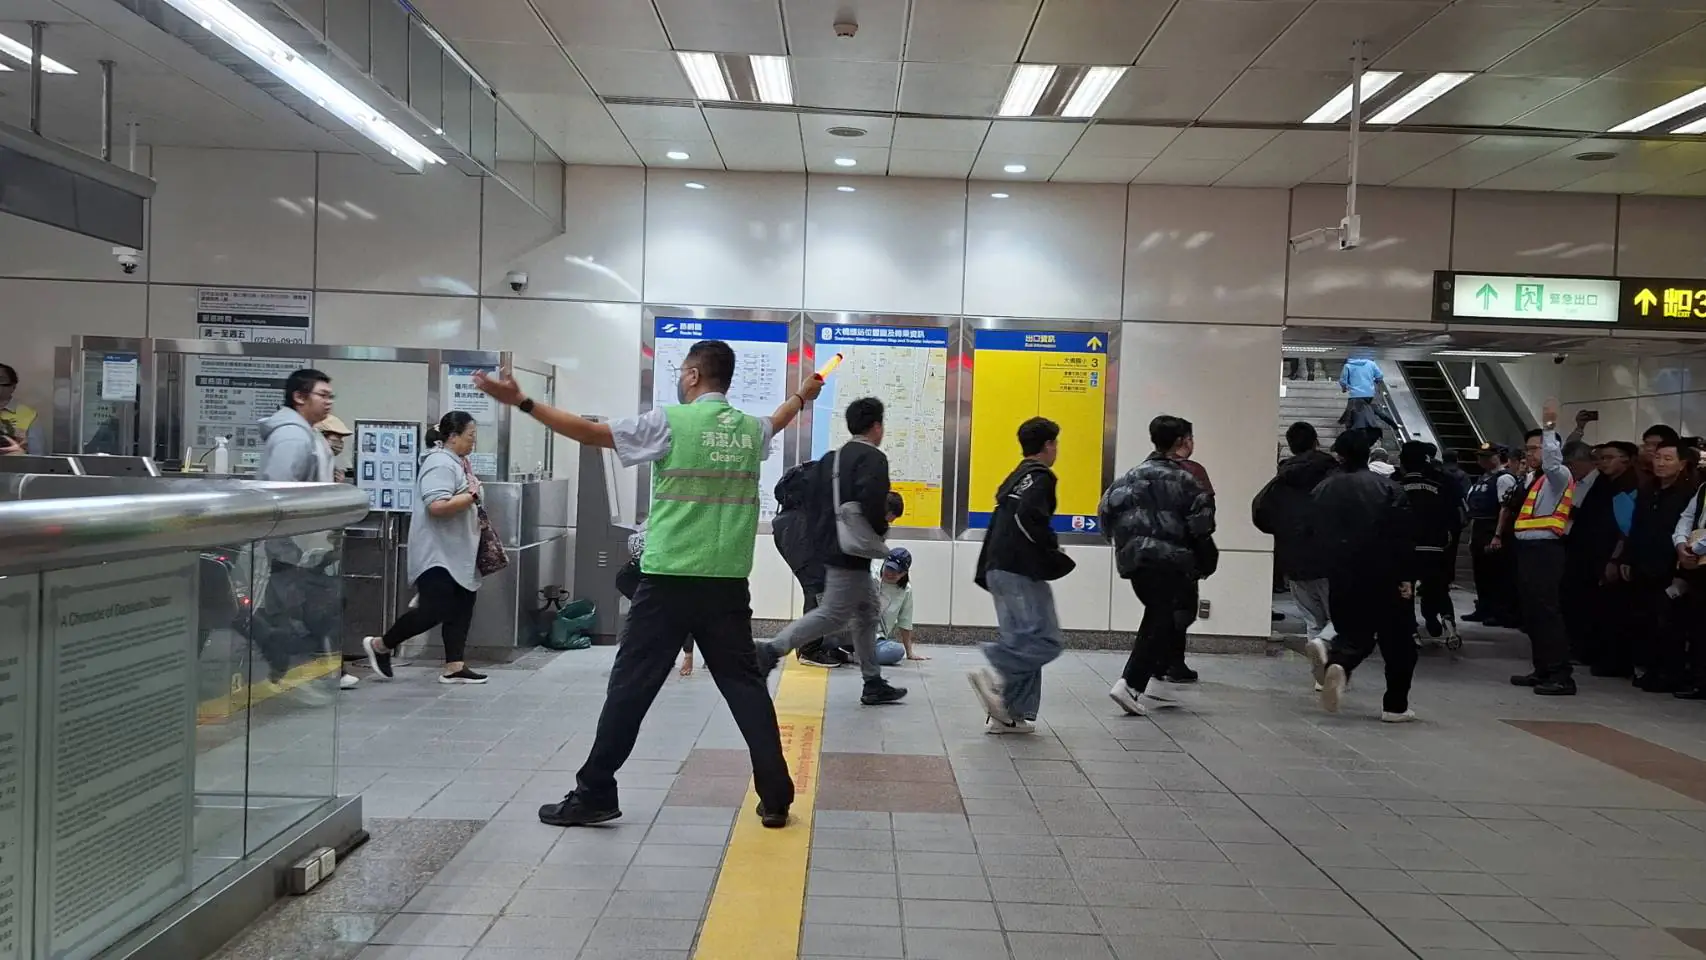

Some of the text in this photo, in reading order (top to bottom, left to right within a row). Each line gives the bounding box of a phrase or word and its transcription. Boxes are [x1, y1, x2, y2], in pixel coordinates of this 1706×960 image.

[1550, 293, 1598, 306] 緊急出口
[1664, 288, 1693, 317] 出口
[204, 329, 245, 339] 週一至週五
[1091, 358, 1099, 368] 3
[702, 431, 753, 449] 清潔人員
[711, 451, 744, 462] Cleaner
